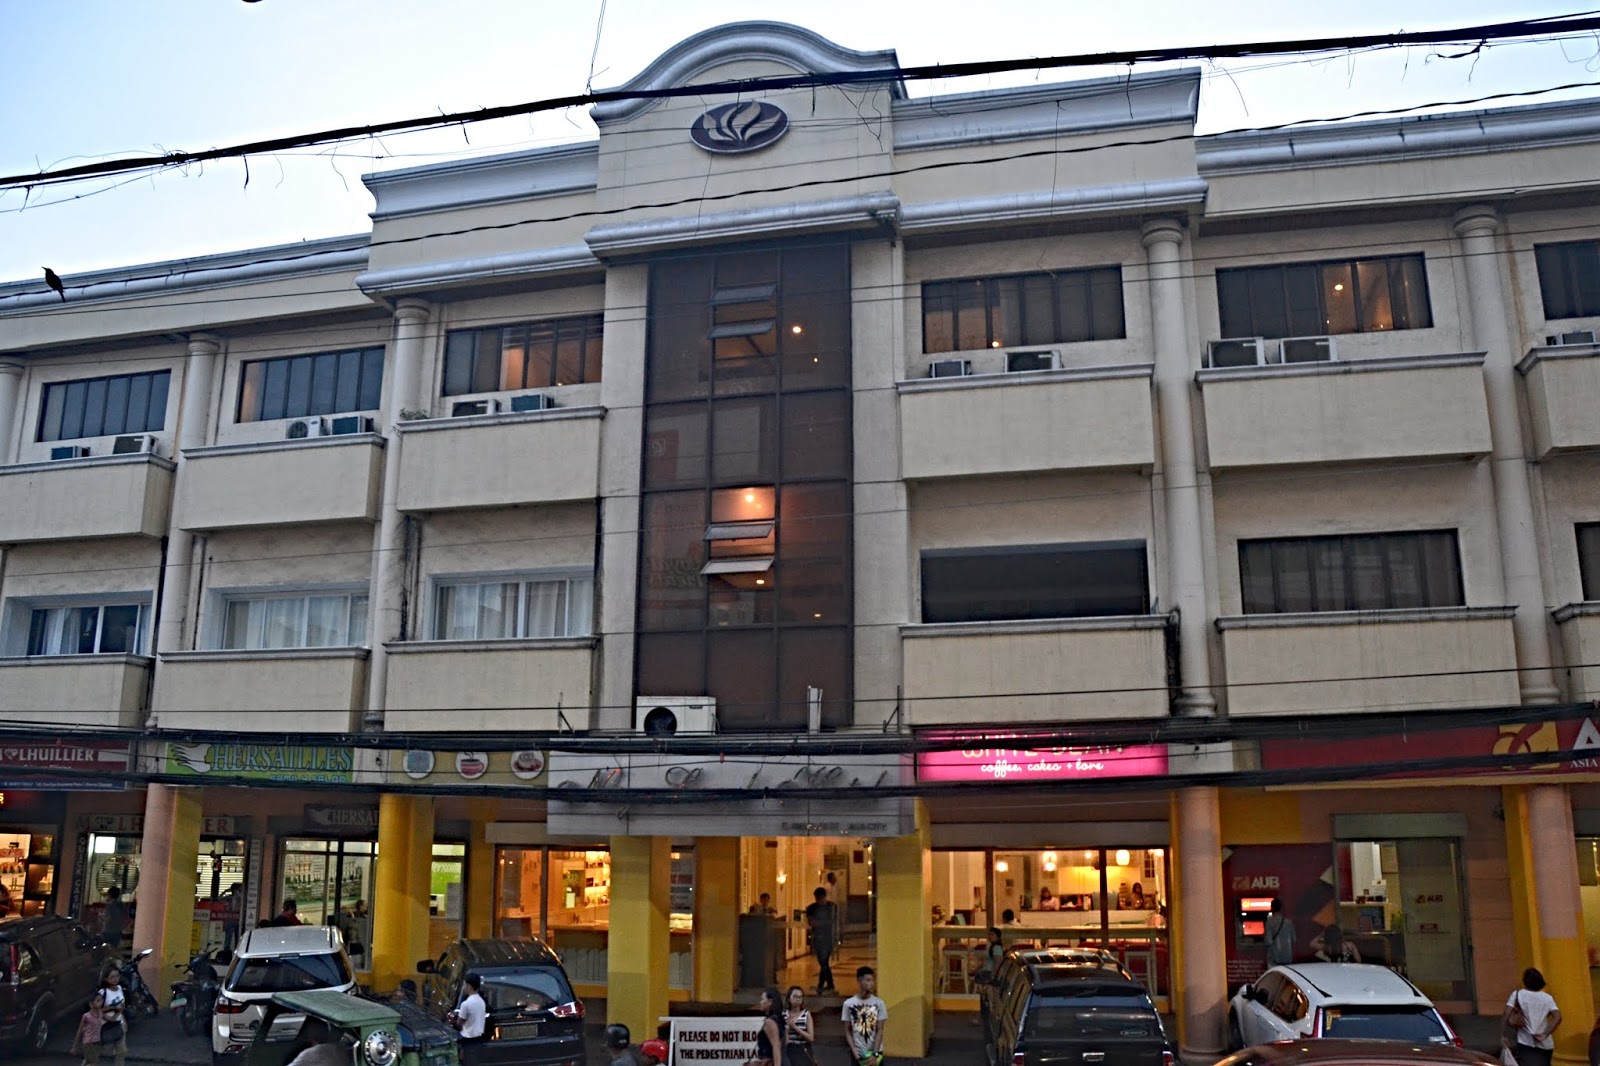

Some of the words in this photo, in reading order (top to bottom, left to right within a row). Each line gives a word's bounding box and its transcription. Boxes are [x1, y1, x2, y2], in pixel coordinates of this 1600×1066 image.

[19, 747, 94, 762] LHUILLIER
[210, 743, 352, 773] HERSAILLES
[980, 759, 1022, 778] coffee,
[1027, 758, 1061, 772] cakes
[1075, 757, 1104, 772] love
[1570, 758, 1598, 769] ASIA
[1251, 876, 1280, 889] AUB
[679, 1031, 708, 1042] PLEASE
[710, 1031, 720, 1042] DO
[722, 1031, 740, 1042] NOT
[680, 1049, 694, 1059] THE
[696, 1049, 745, 1060] PEDESTRIAN
